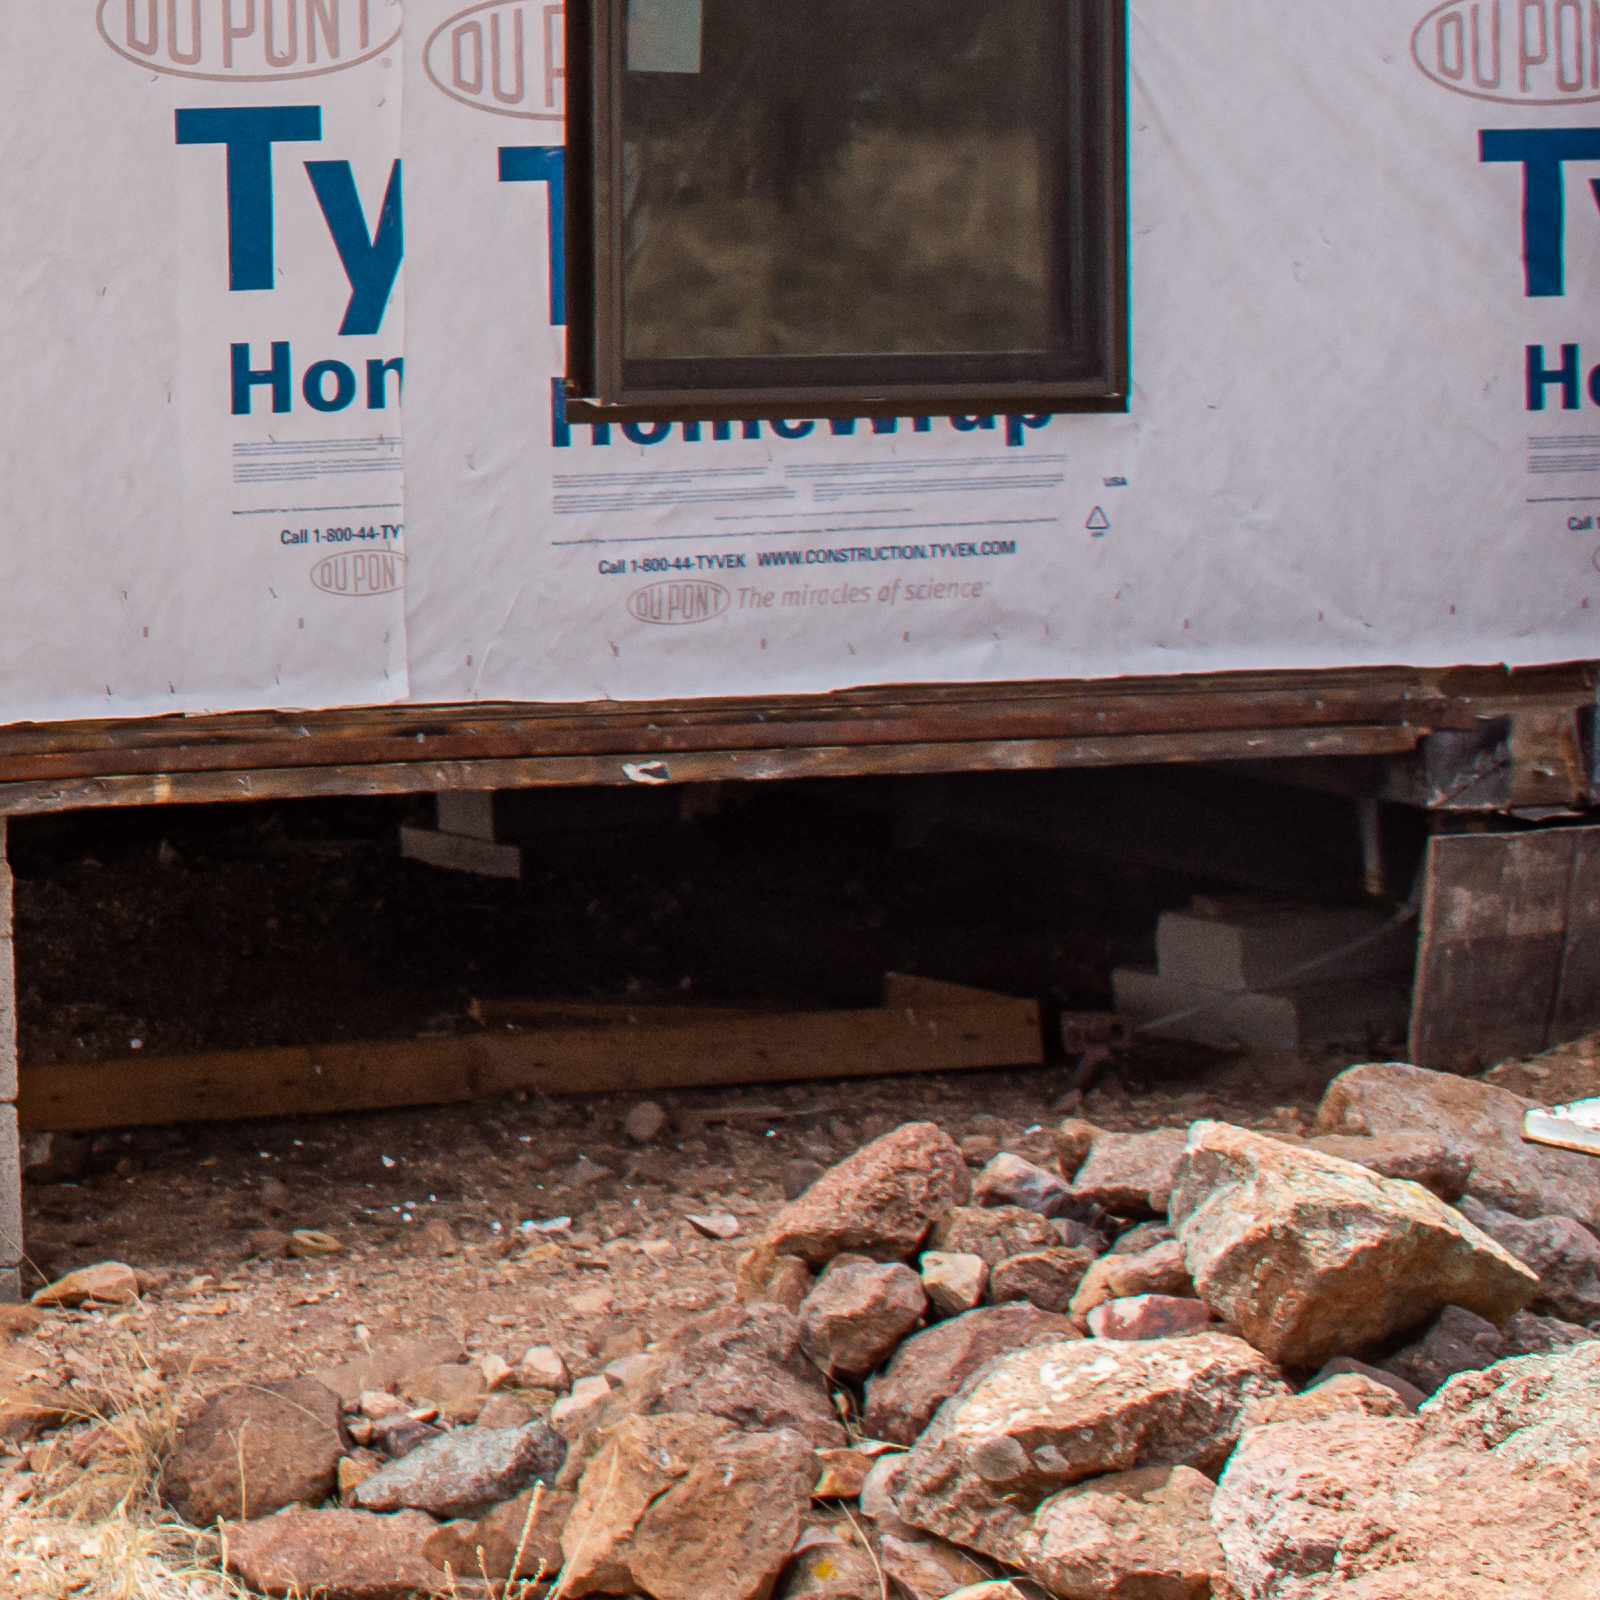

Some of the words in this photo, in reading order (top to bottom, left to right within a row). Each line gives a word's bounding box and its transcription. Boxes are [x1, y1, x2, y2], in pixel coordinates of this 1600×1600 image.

[281, 529, 308, 544] Call
[313, 524, 404, 544] 1-800-44-TY
[598, 559, 626, 574] Call
[631, 553, 746, 572] 1-800-44-TYVEK
[757, 540, 1016, 567] WWW.CONSTRUCTION.TYVEK.COM
[738, 586, 775, 609] The
